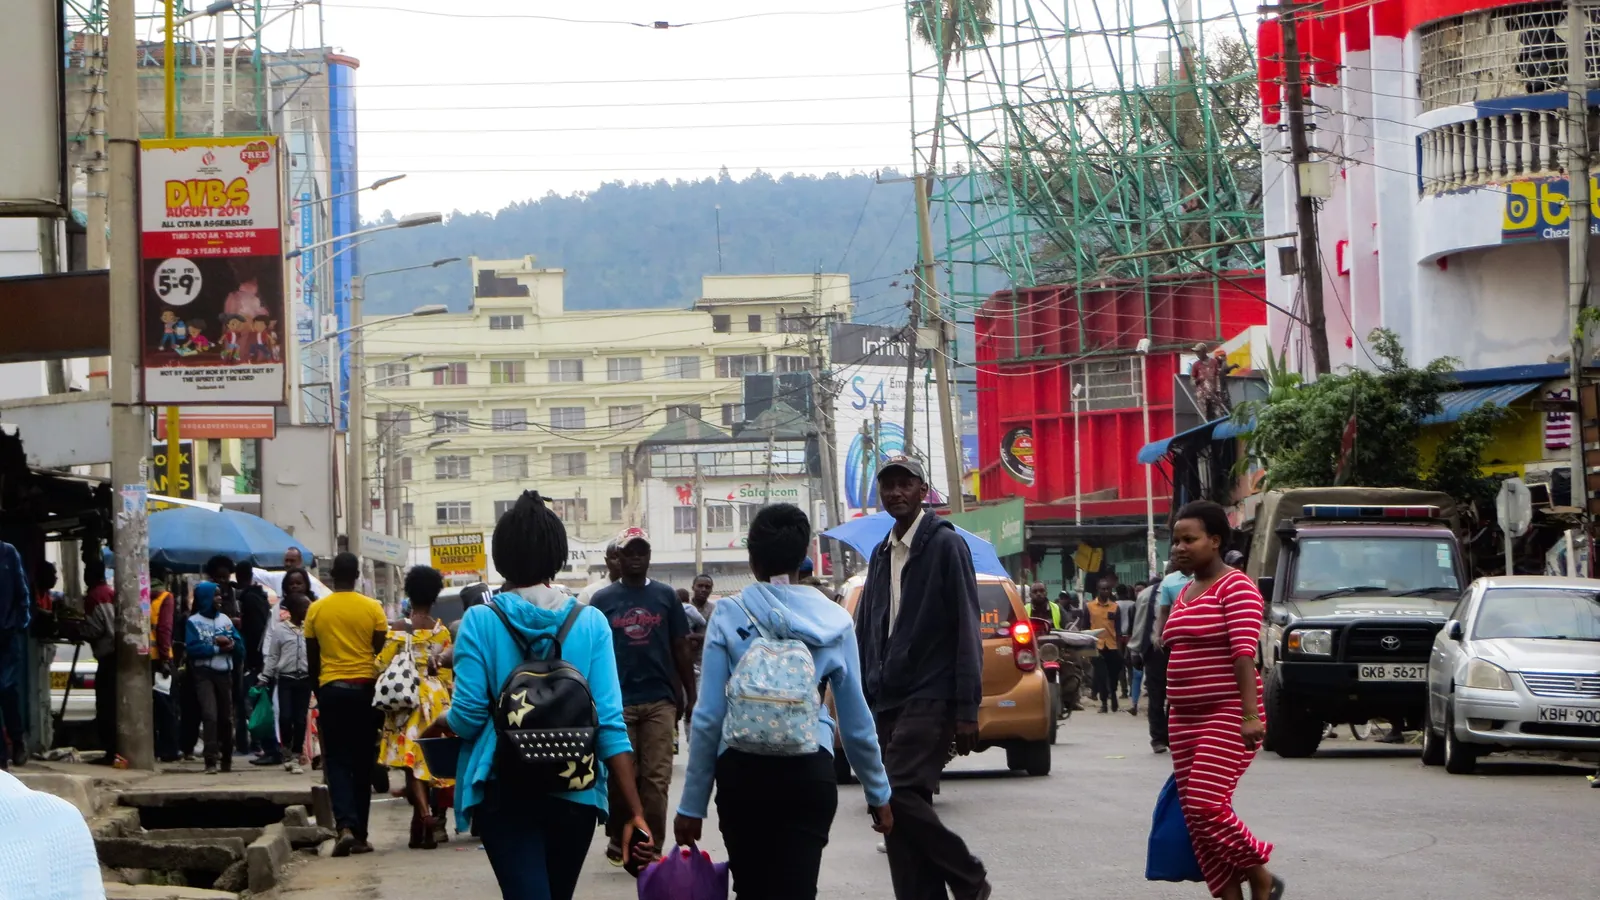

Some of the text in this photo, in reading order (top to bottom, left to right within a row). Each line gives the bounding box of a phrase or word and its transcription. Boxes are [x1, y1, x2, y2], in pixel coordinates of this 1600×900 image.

[241, 151, 268, 159] FREE
[165, 177, 250, 208] DVBS
[166, 205, 250, 218] AUGUST 2019
[177, 220, 202, 228] CITAM
[204, 219, 254, 228] ASSEMBLIES
[851, 375, 887, 412] S4
[740, 486, 798, 498] Safaicom
[433, 545, 482, 556] NAIROBI
[440, 555, 476, 564] DIRECT
[1361, 667, 1424, 678] GKB 562T
[1540, 708, 1567, 721] KBH
